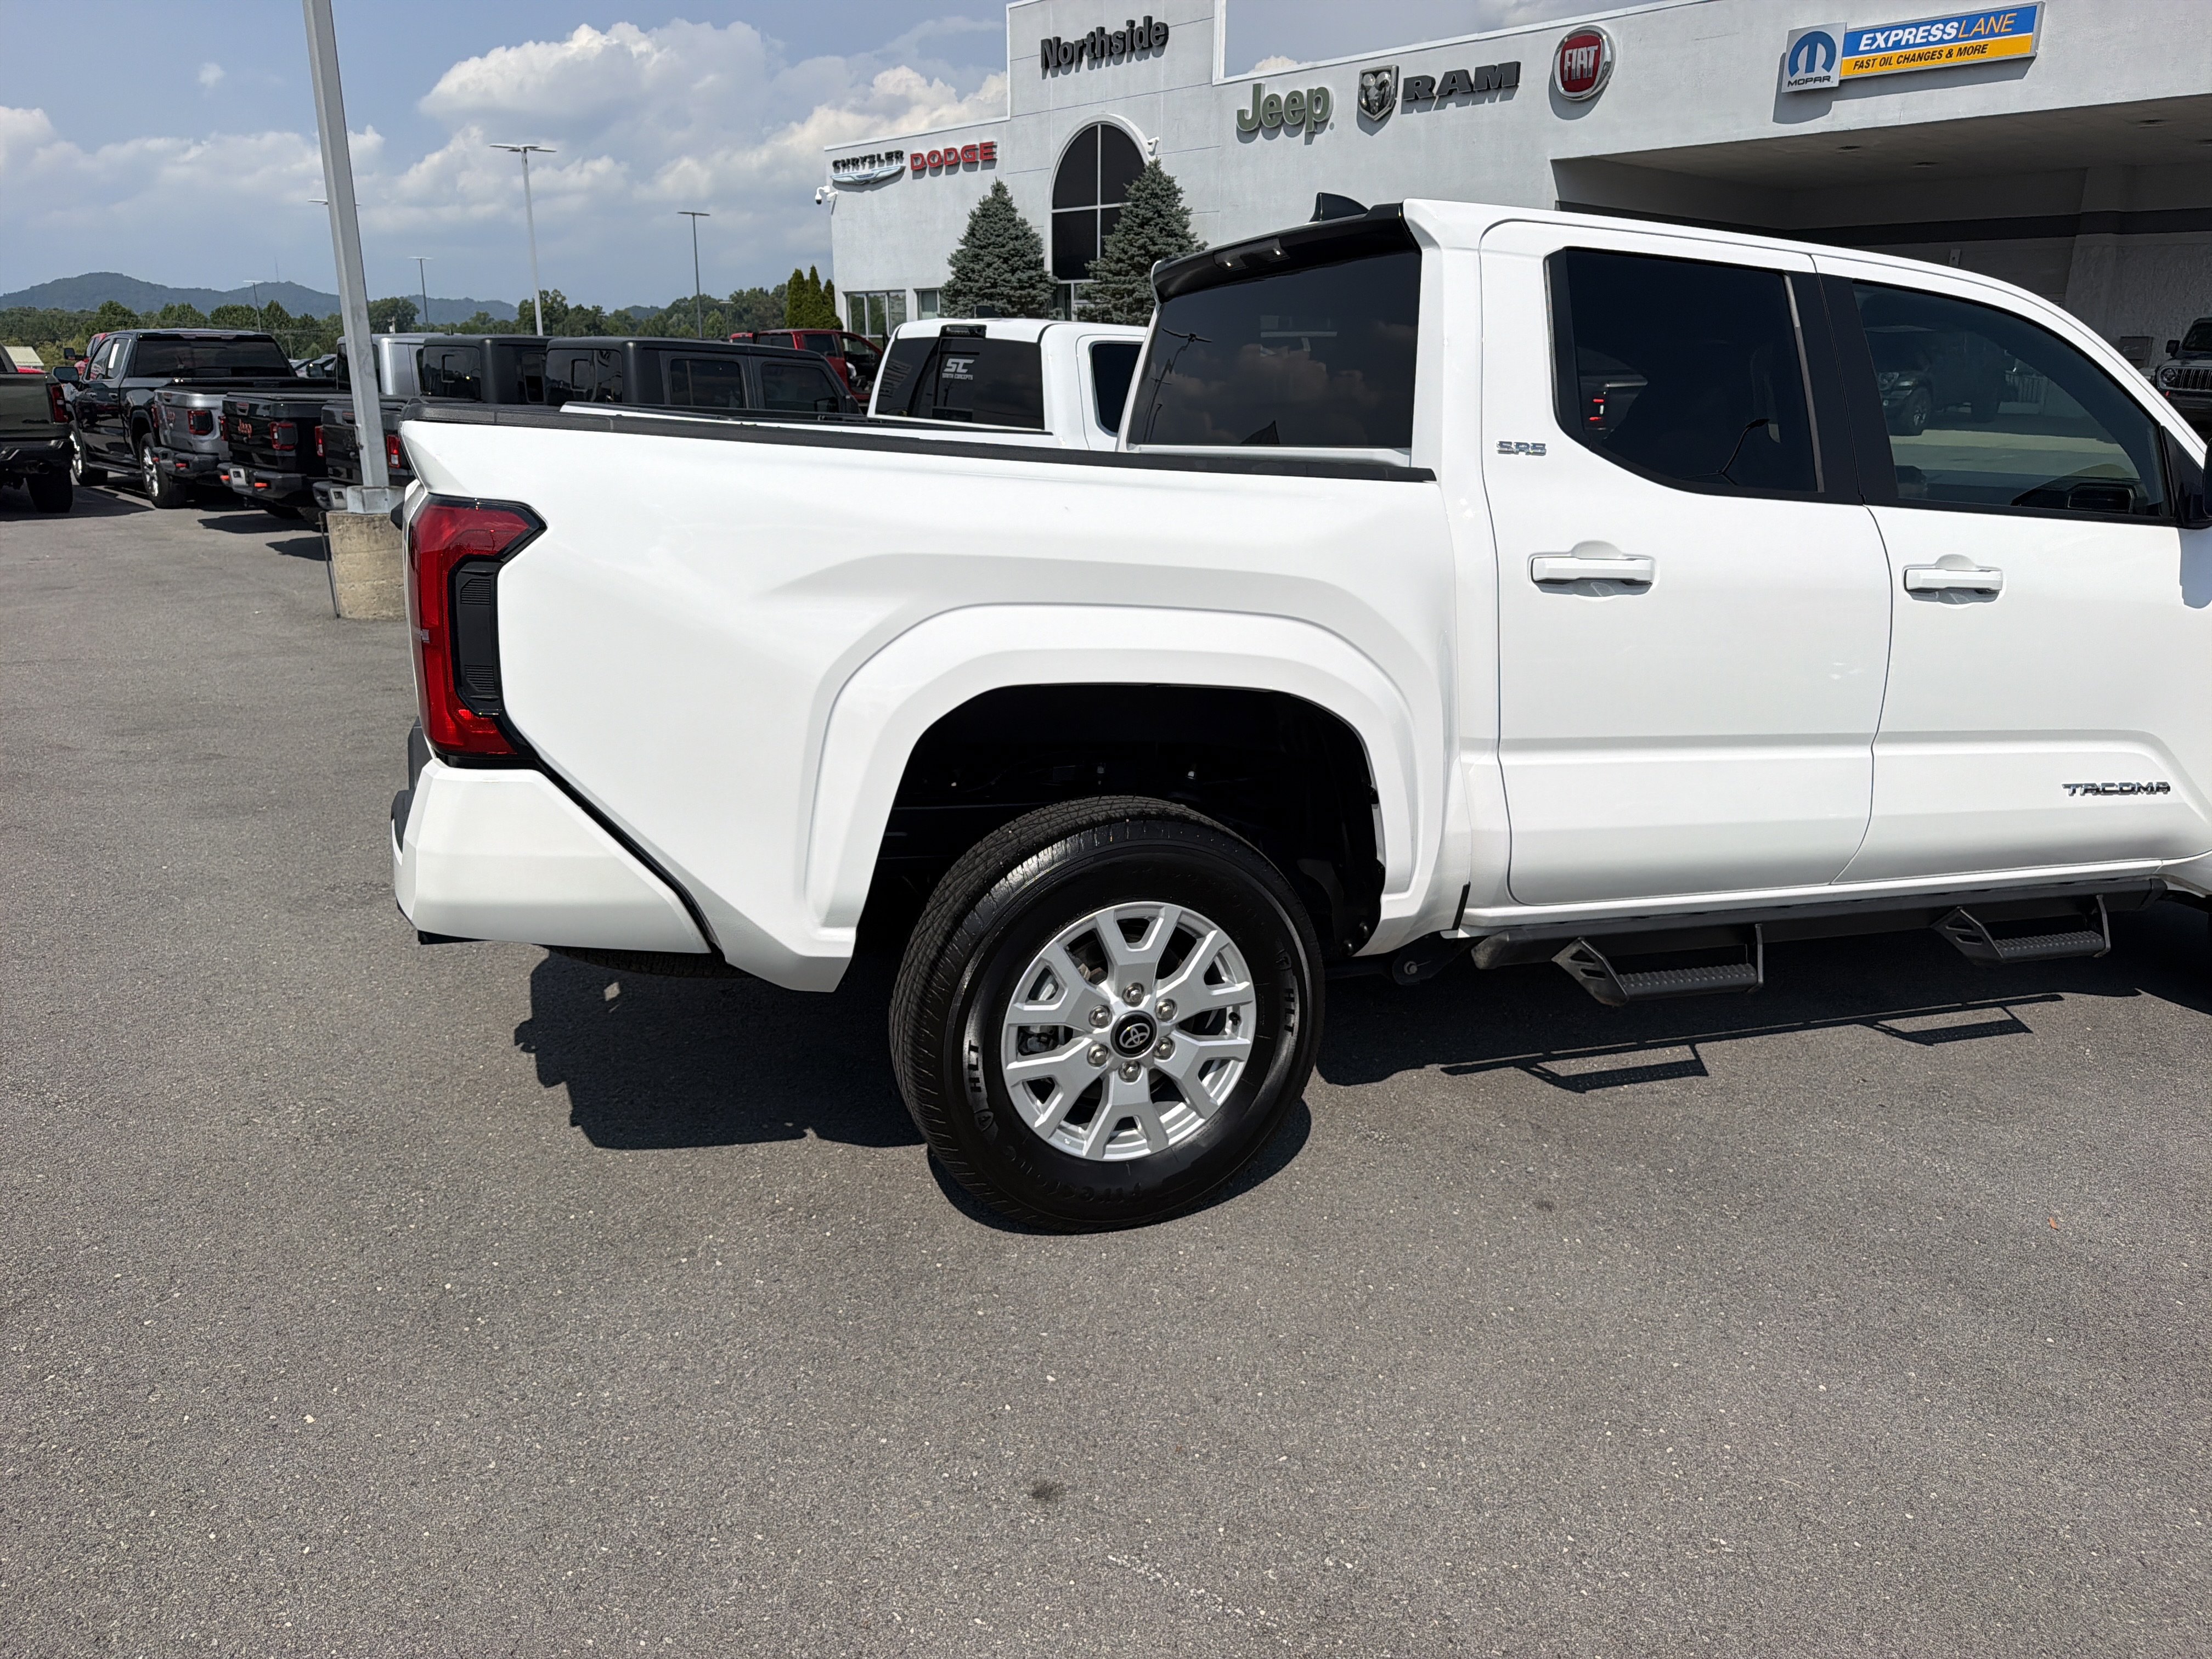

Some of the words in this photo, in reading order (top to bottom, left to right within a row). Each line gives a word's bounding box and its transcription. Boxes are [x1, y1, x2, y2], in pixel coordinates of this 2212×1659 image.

[1041, 15, 1169, 70] Northside
[1853, 58, 1877, 71] FAST
[1879, 56, 1893, 67] OIL
[1896, 49, 1944, 65] CHANGES
[1945, 48, 1954, 59] &
[1956, 43, 1989, 58] MORE
[1564, 45, 1599, 82] FIAT
[1403, 61, 1521, 101] RAM
[1787, 75, 1831, 87] MOPAR
[1237, 83, 1334, 132] Jeep
[832, 150, 904, 168] CHRYSLER
[910, 141, 997, 171] DODGE
[1496, 441, 1547, 456] SR5
[2061, 781, 2171, 797] TACOMA
